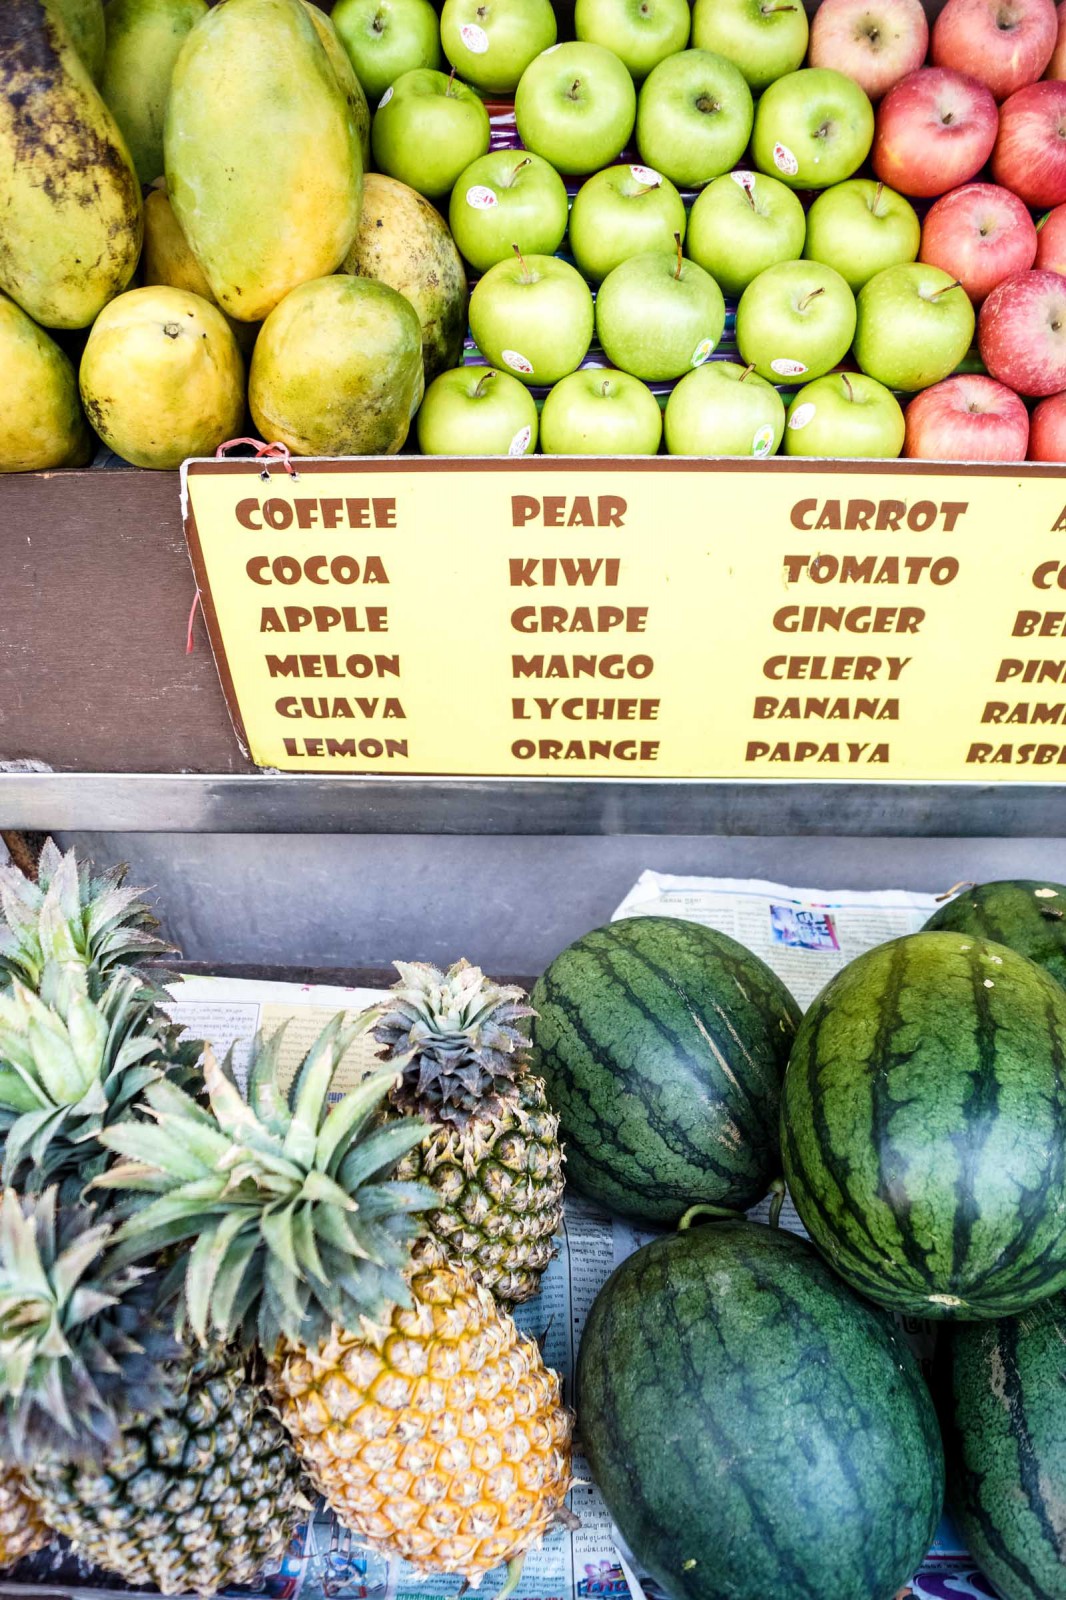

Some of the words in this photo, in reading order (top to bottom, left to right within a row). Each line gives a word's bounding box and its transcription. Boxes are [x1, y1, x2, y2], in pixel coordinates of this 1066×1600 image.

[235, 497, 397, 531] COFFEE
[511, 495, 628, 528] PEAR
[790, 498, 969, 532] CARROT
[245, 555, 390, 586] COCOA
[508, 558, 621, 587] KIWI
[783, 554, 960, 586] TOMATO
[260, 605, 389, 633] APPLE
[510, 605, 649, 634] GRAPE
[772, 605, 926, 634] GINGER
[1011, 610, 1066, 637] BE
[265, 653, 400, 679] MELON
[511, 654, 654, 680] MANGO
[762, 655, 912, 681] CELERY
[995, 658, 1066, 684] PIN
[275, 696, 407, 719] GUAVA
[511, 697, 661, 721] LYCHEE
[753, 696, 899, 720] BANANA
[980, 701, 1066, 725] RAM
[282, 737, 409, 759] LEMON
[511, 739, 660, 761] ORANGE
[745, 741, 889, 763] PAPAYA
